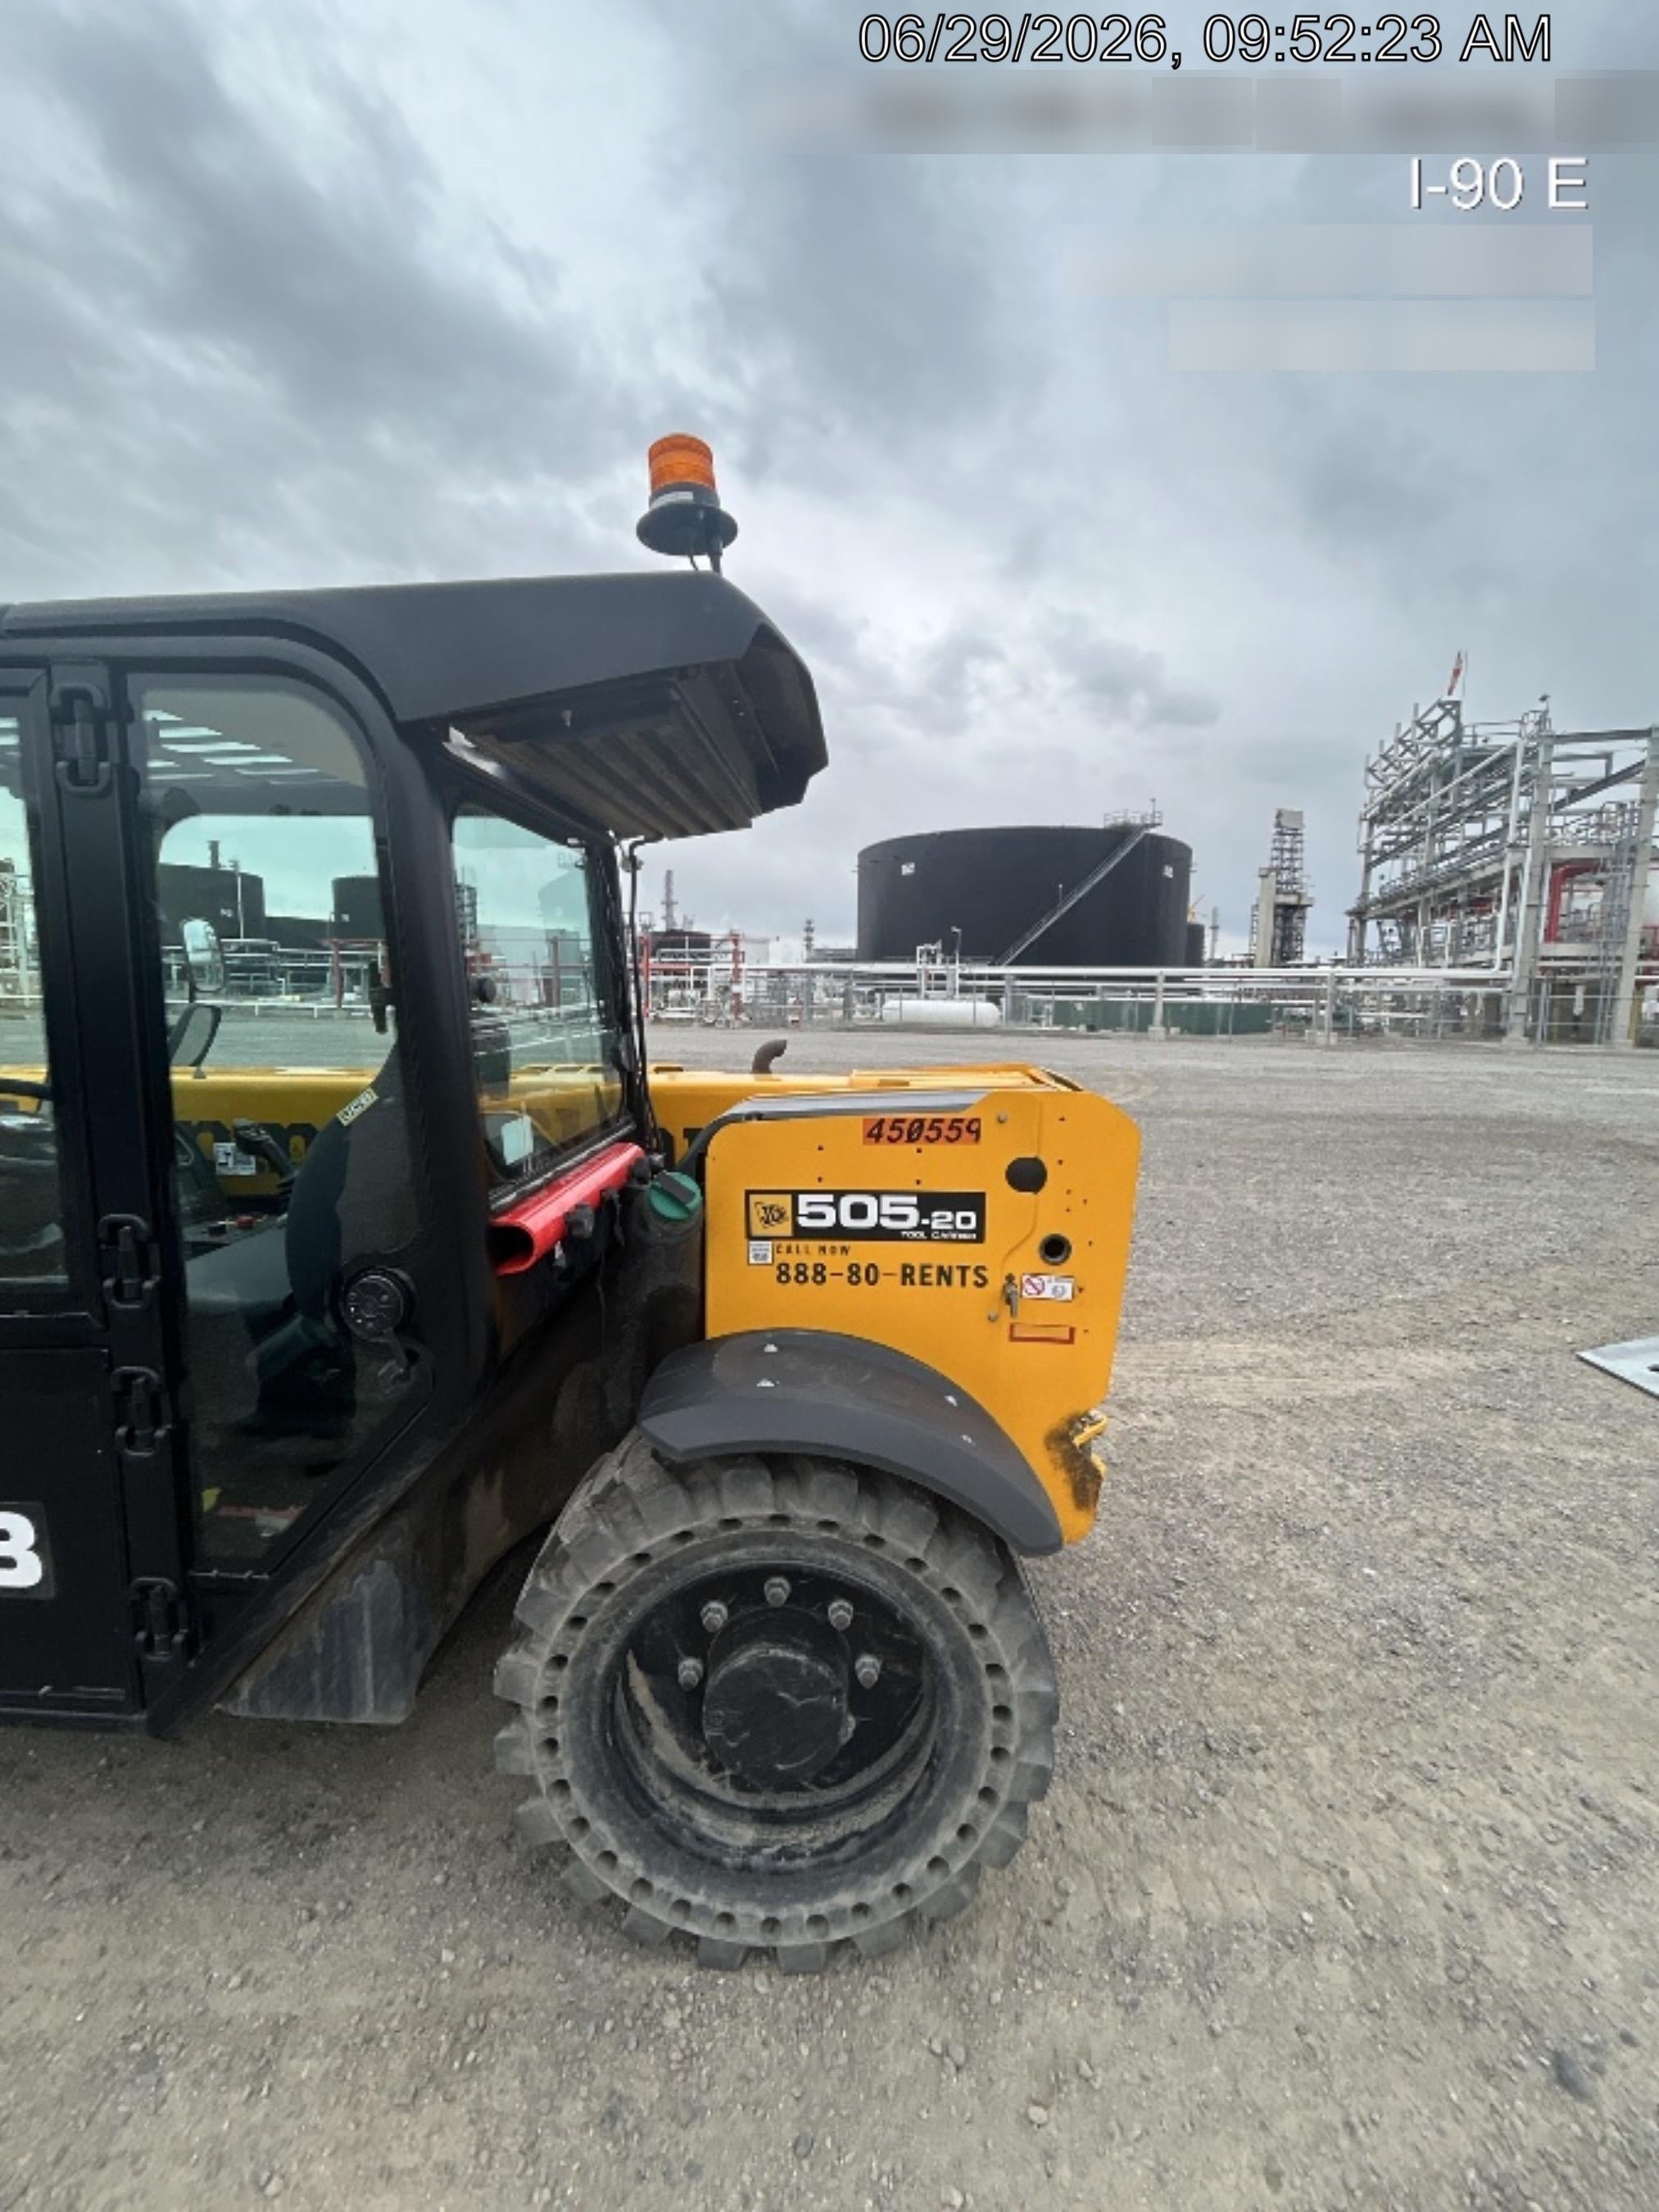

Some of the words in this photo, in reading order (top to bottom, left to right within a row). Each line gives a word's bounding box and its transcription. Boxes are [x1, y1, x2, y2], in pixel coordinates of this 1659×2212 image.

[866, 1117, 981, 1144] 450559
[776, 1244, 811, 1254] CALL
[818, 1245, 850, 1256] NOW
[777, 1262, 989, 1288] 888-80-RENTS
